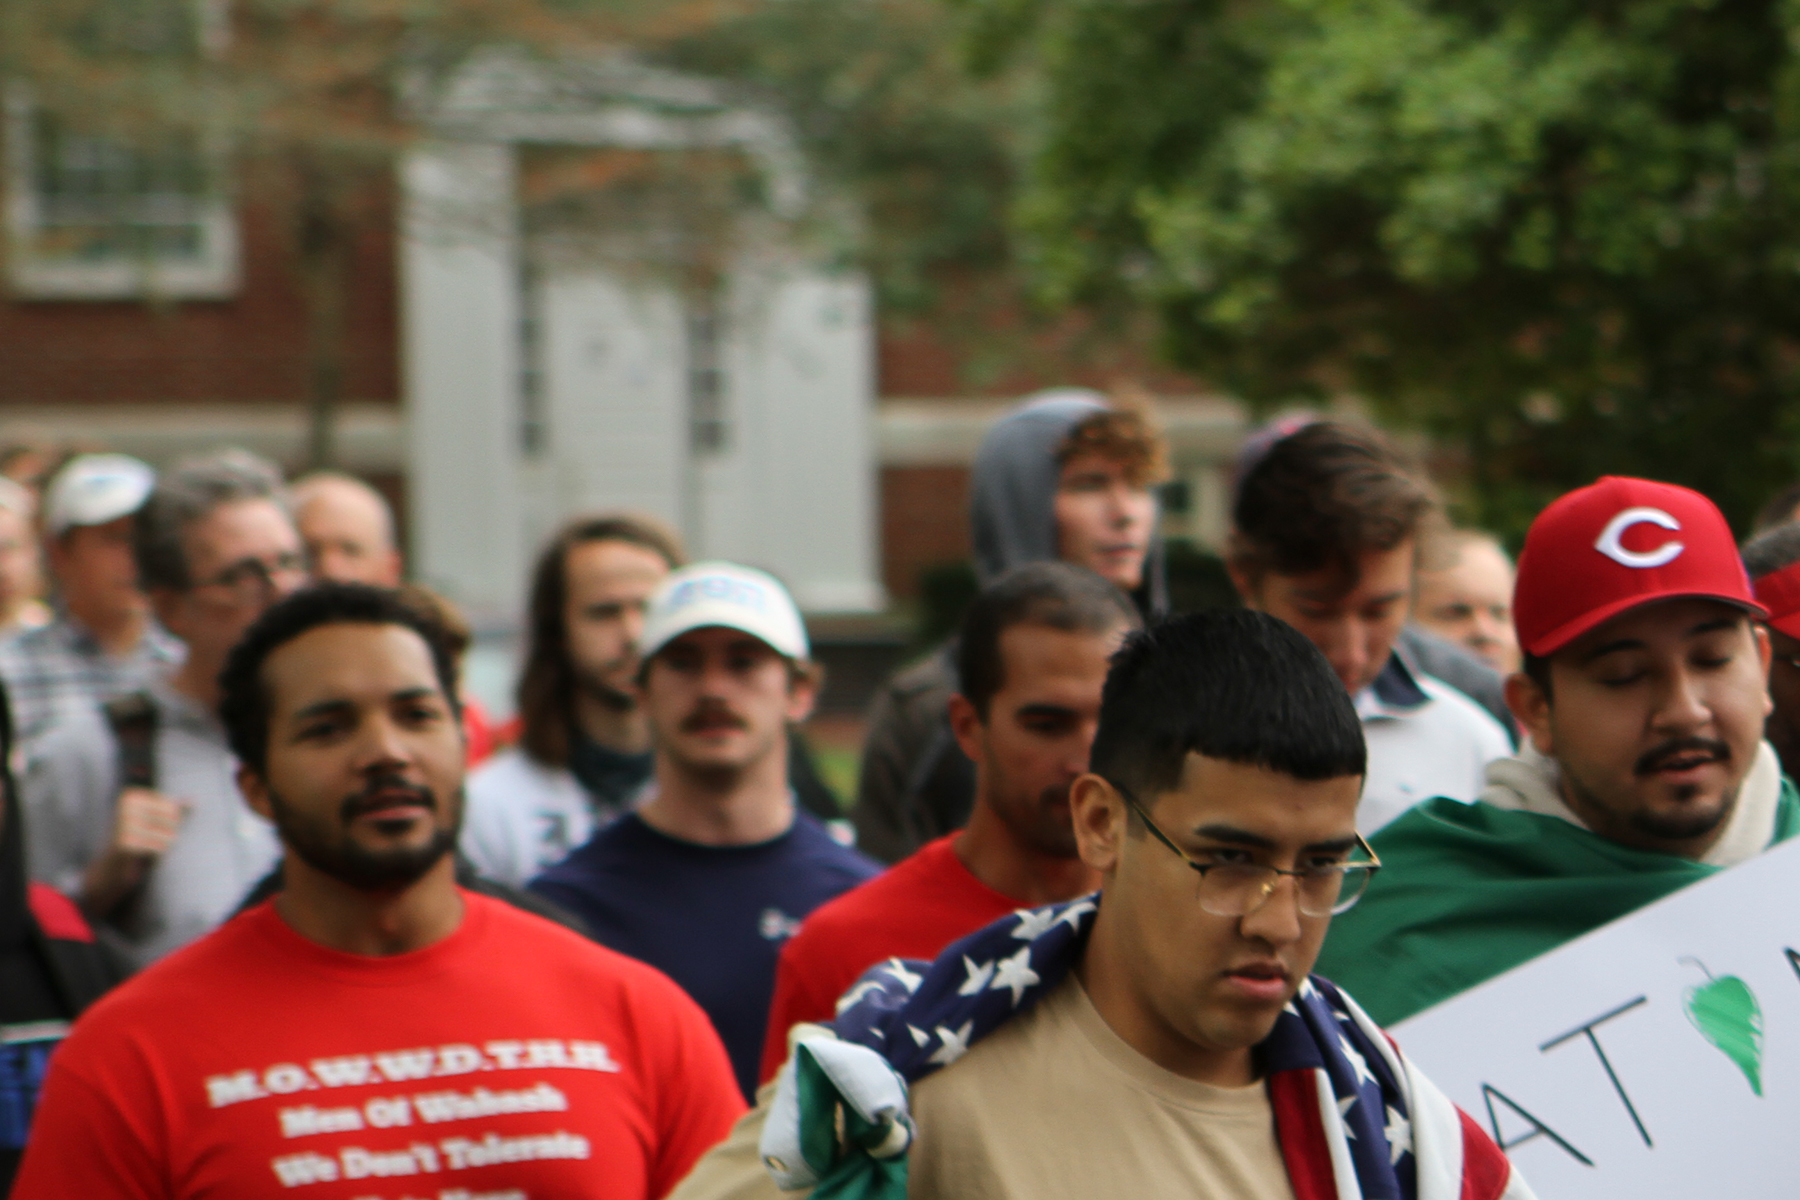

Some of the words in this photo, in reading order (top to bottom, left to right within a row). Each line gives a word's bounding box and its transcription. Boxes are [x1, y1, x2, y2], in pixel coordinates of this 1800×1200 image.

[1593, 505, 1685, 569] C
[280, 1104, 364, 1139] Men
[363, 1096, 412, 1128] Of
[413, 1081, 568, 1124] Wabash
[271, 1152, 340, 1188] We
[340, 1141, 440, 1180] Don't
[439, 1129, 591, 1170] Tolerate
